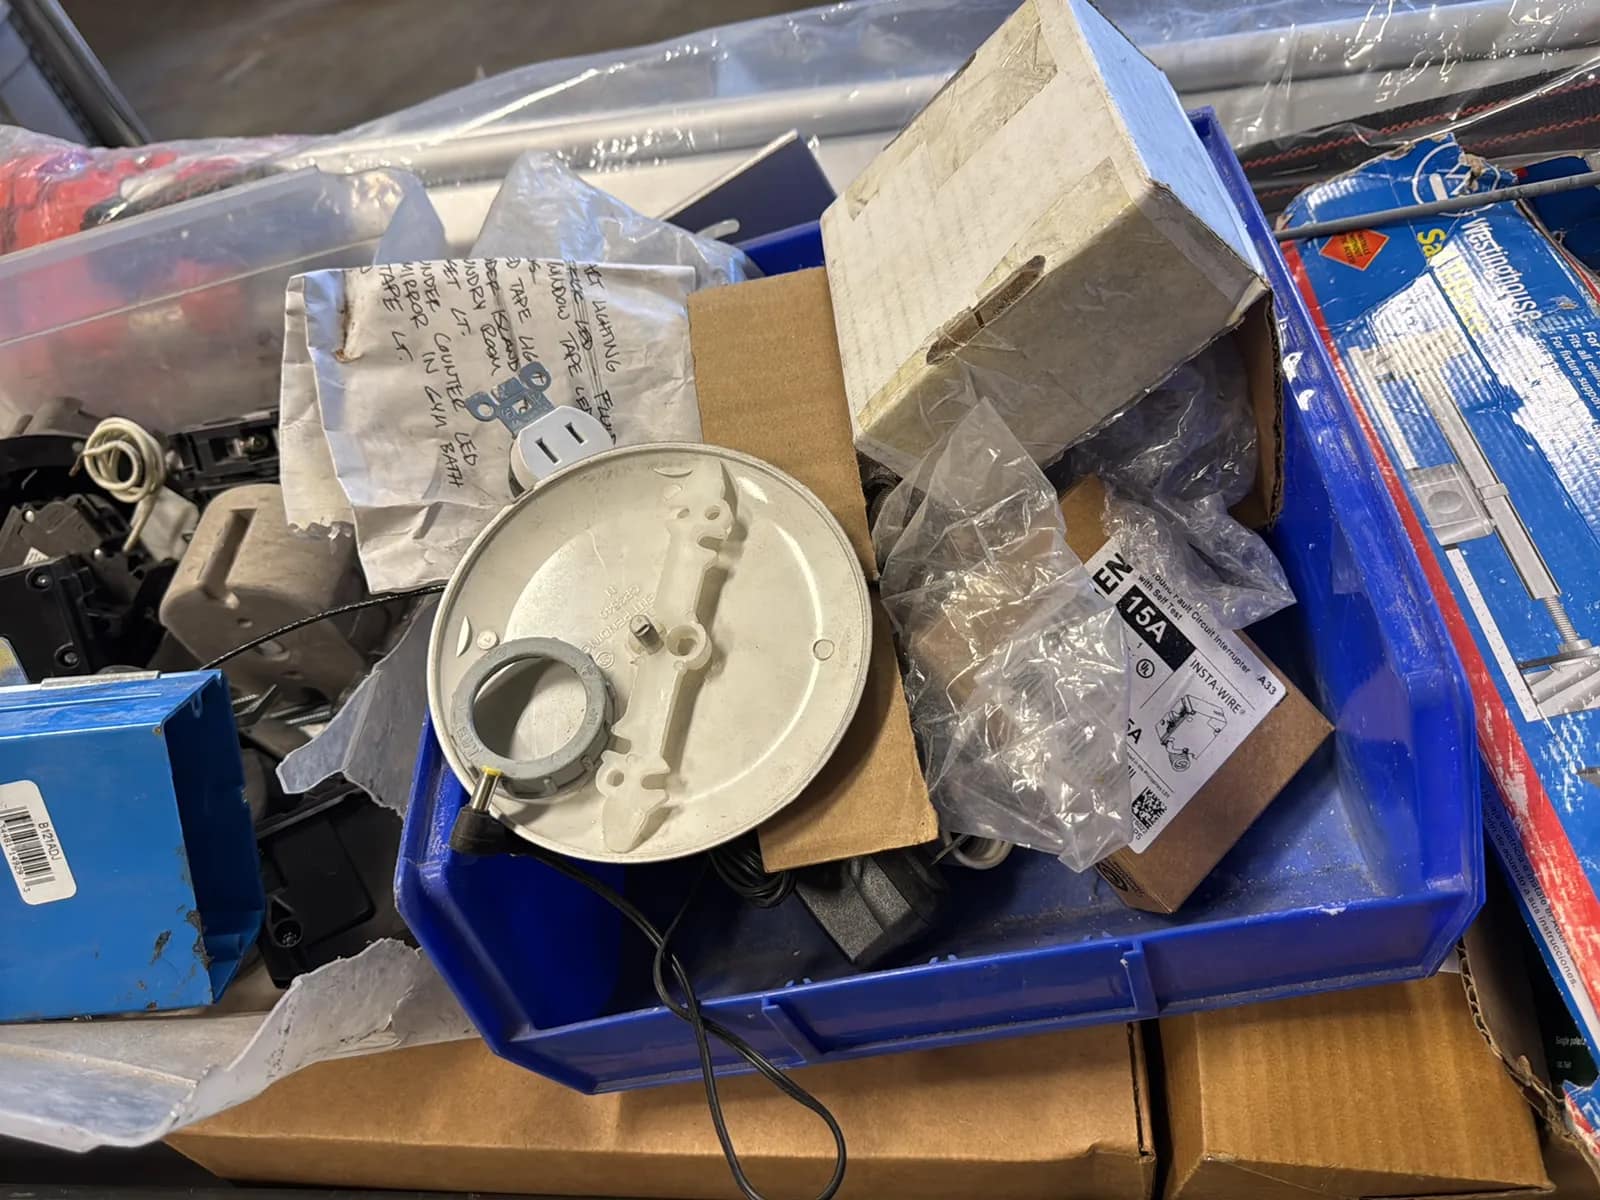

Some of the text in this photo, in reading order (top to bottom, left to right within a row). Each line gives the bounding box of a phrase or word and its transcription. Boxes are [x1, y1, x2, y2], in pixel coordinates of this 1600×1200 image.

[379, 264, 403, 312] TAPE
[1462, 217, 1543, 322] Westinghouse
[511, 278, 532, 323] TAPE
[547, 262, 570, 320] WINDOW
[560, 332, 583, 377] TAPE
[481, 323, 500, 376] ROOM
[491, 309, 519, 372] ISLAND
[592, 300, 622, 373] LIGHTING
[1550, 336, 1565, 349] For
[1560, 350, 1583, 377] fixture
[1566, 333, 1582, 349] Fits
[1577, 350, 1593, 360] all
[1582, 331, 1600, 348] For
[402, 262, 429, 328] MIRROR
[422, 352, 439, 375] IN
[440, 442, 463, 488] BATH
[434, 332, 466, 412] COUNTER
[454, 432, 477, 466] LED
[1126, 595, 1168, 644] 15A
[1138, 574, 1183, 621] with Self Test
[1191, 611, 1216, 638] Circuit
[1214, 634, 1251, 673] Interrupter
[1257, 675, 1278, 696] A33
[38, 822, 62, 861] B121ADJ
[1538, 915, 1578, 988] instrucciones.
